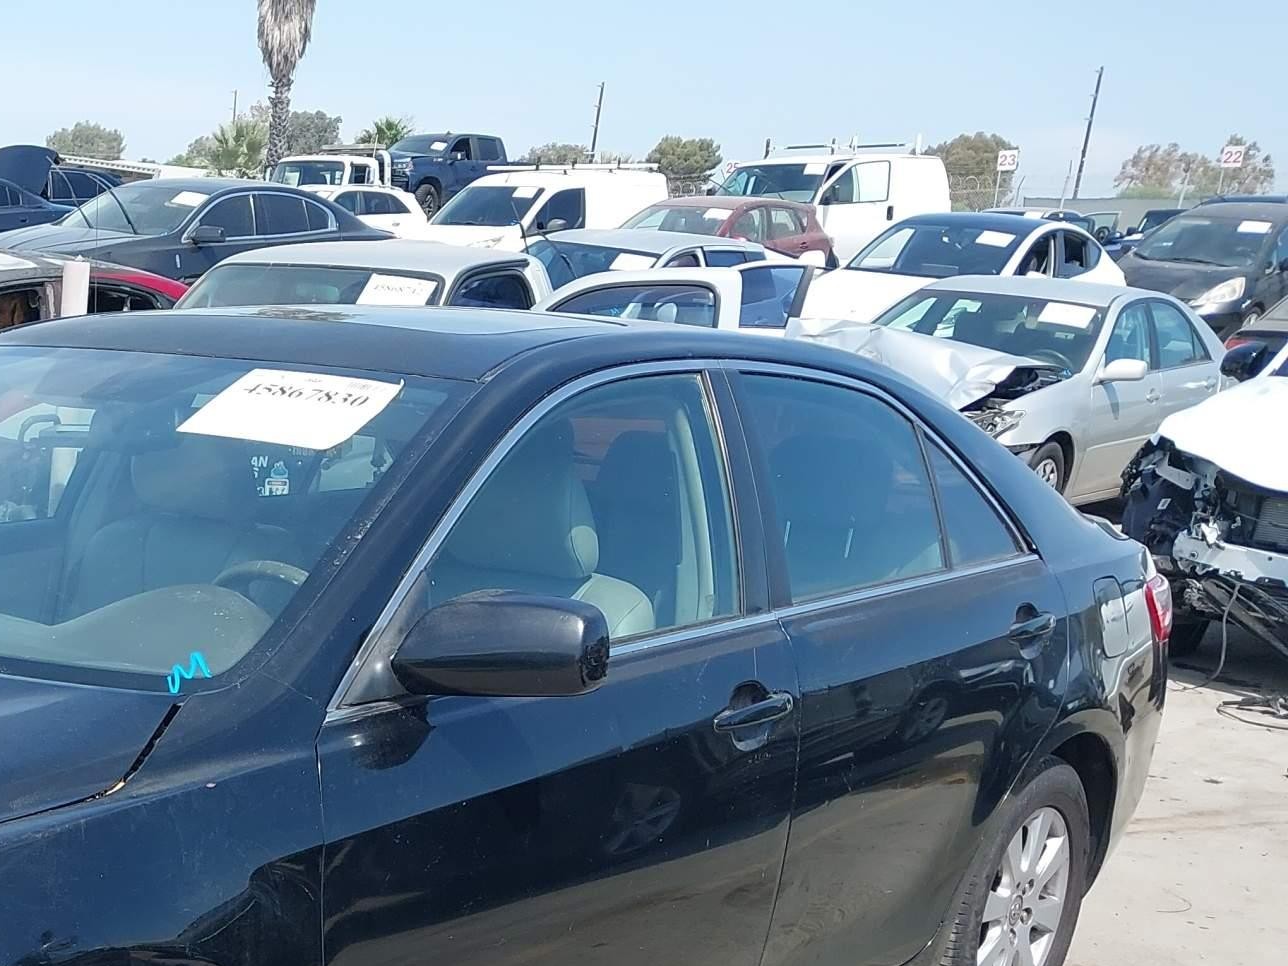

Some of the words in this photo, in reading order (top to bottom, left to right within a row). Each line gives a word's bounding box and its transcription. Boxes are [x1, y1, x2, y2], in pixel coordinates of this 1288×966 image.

[999, 153, 1017, 167] 23
[1223, 150, 1243, 164] 22
[243, 383, 370, 407] 45867830
